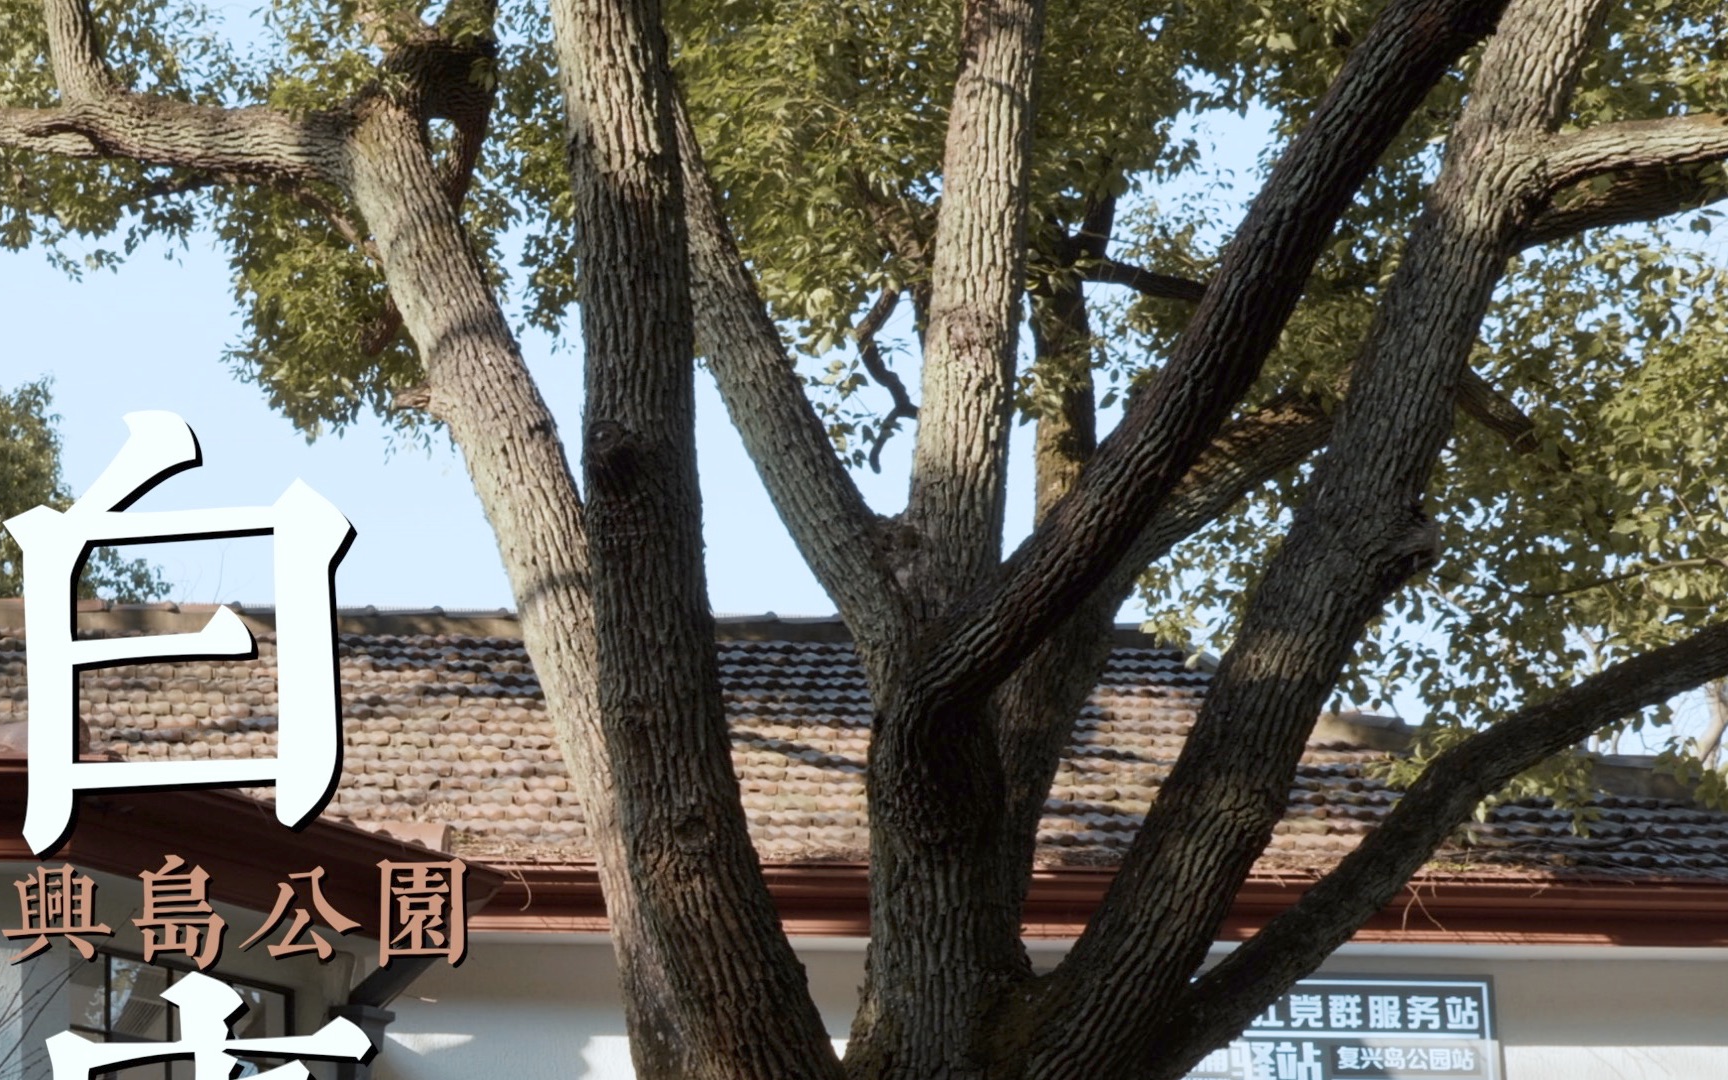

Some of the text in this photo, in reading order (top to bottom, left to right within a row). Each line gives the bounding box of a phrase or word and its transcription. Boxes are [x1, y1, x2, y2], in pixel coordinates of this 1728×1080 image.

[1337, 1046, 1475, 1071] 复兴岛公园站
